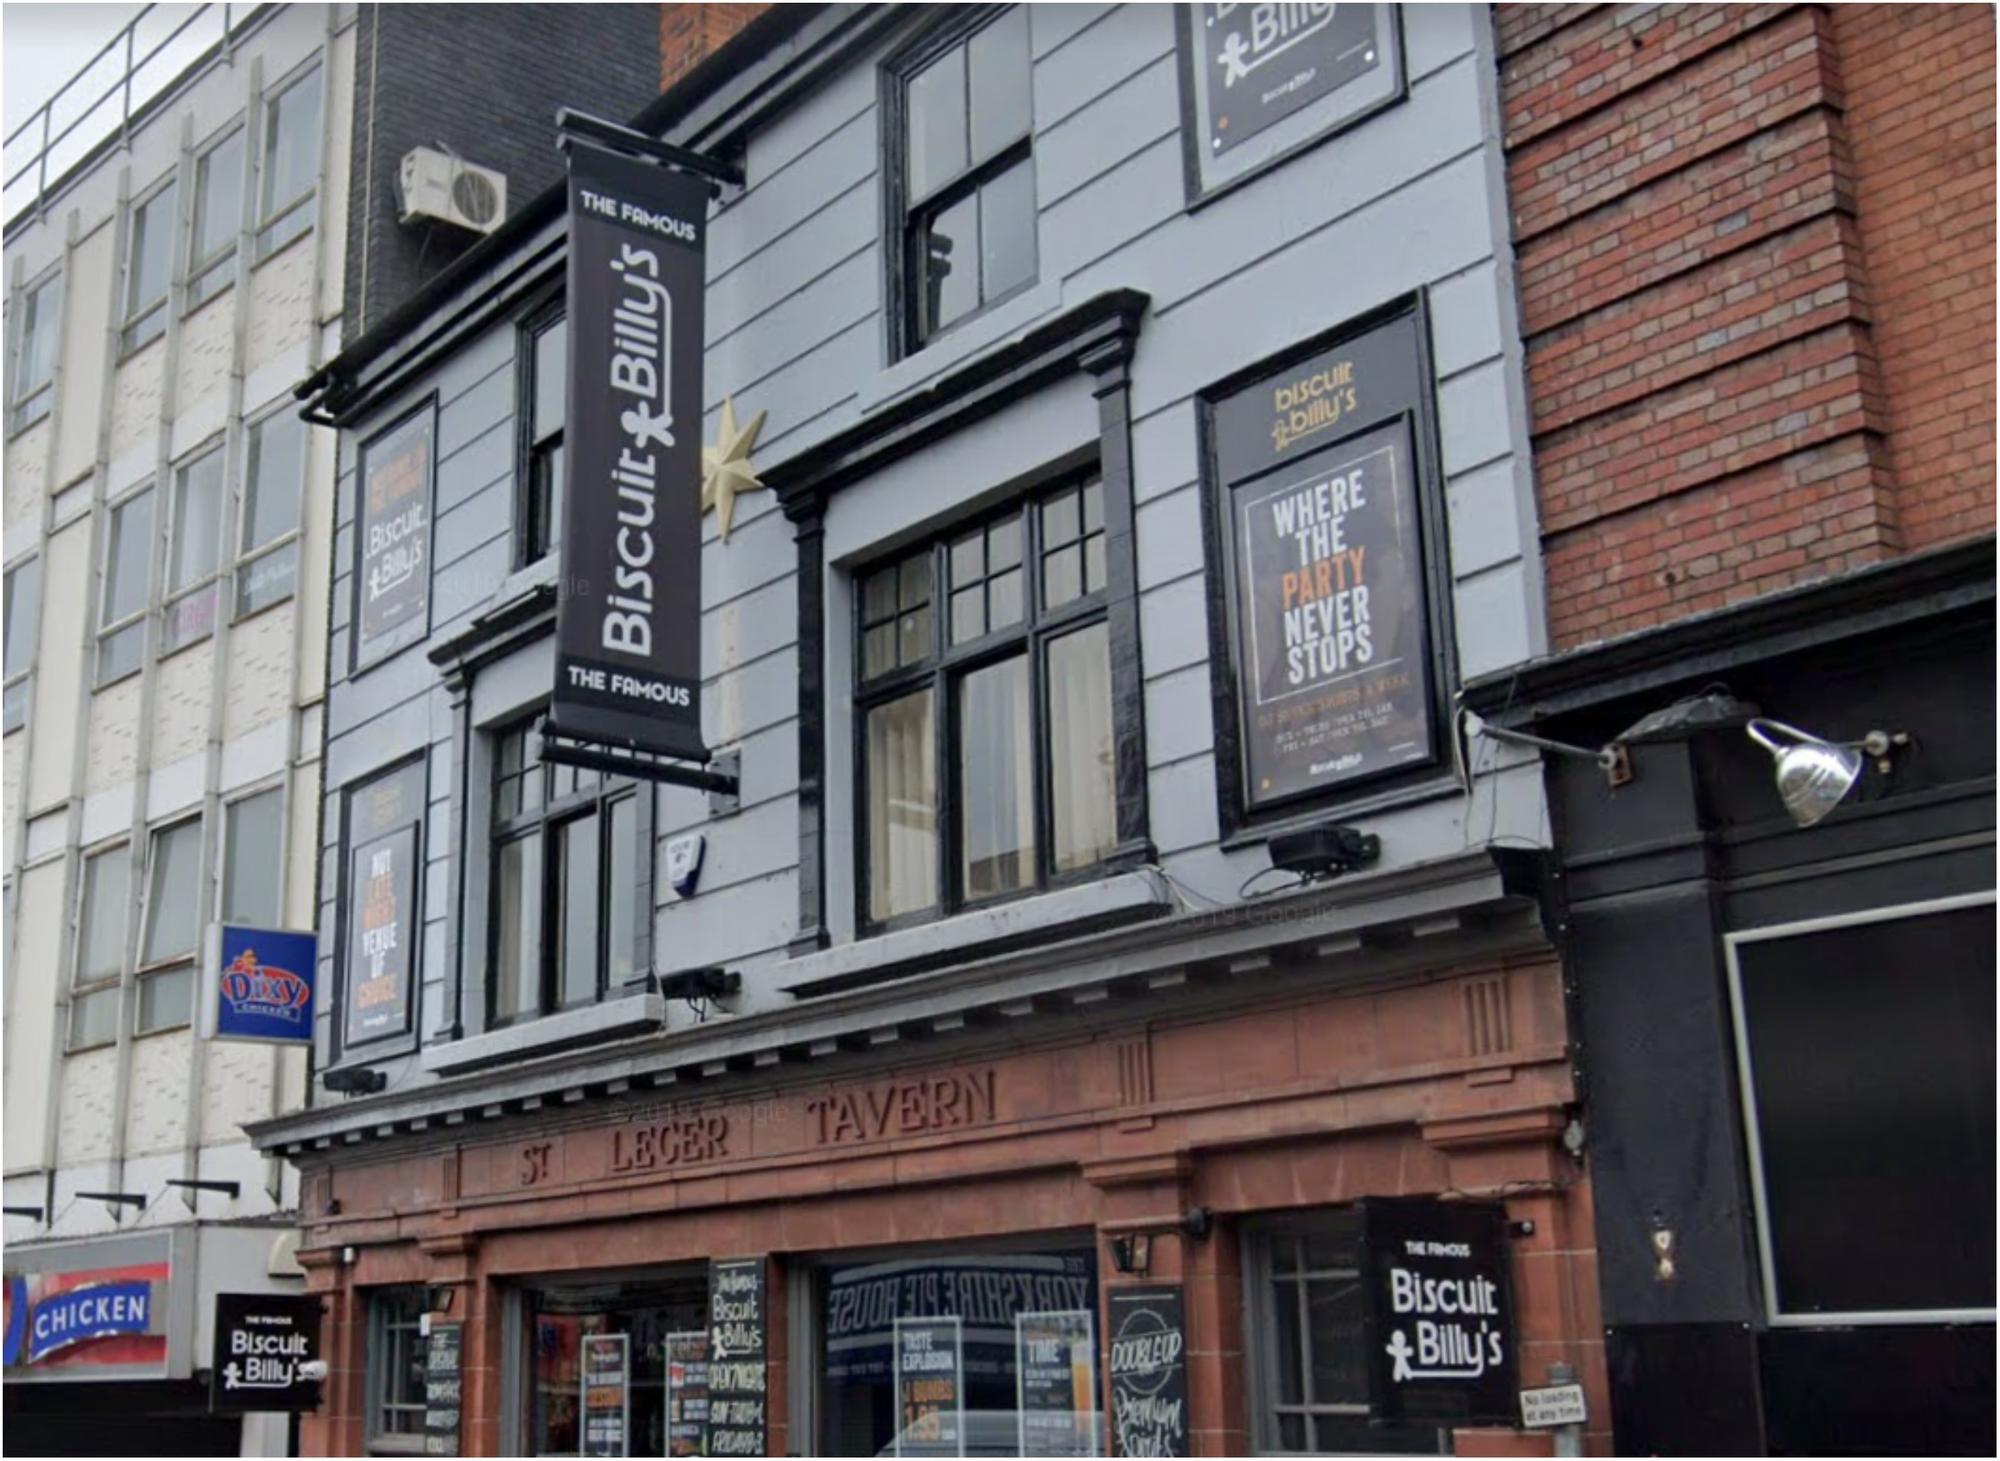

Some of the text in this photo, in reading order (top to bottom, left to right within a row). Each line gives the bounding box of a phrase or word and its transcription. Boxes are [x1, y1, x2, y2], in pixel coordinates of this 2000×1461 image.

[580, 190, 696, 241] THE FAMOUS
[1274, 361, 1353, 412] biscuit
[602, 243, 671, 656] Biscuit Billy's
[369, 502, 424, 552] Biscuit
[1272, 468, 1366, 538] WHERE
[379, 537, 424, 585] Billy's
[1294, 515, 1347, 566] THE
[1283, 546, 1366, 609] PARTY
[1284, 585, 1371, 647] NEVER
[1287, 624, 1373, 685] STOPS
[567, 665, 690, 706] THE FAMOUS
[227, 969, 304, 1009] Dixy
[807, 1069, 997, 1144] TAVERN
[1405, 1241, 1471, 1257] THE FAMOUS
[35, 1295, 146, 1339] CHICKEN
[712, 1294, 759, 1321] Biscuit
[1390, 1269, 1498, 1315] Biscuit
[231, 1330, 307, 1355] Biscuit
[902, 1351, 954, 1371] EXPLOSION
[903, 1332, 933, 1350] TASTE
[1416, 1320, 1503, 1377] Billy's
